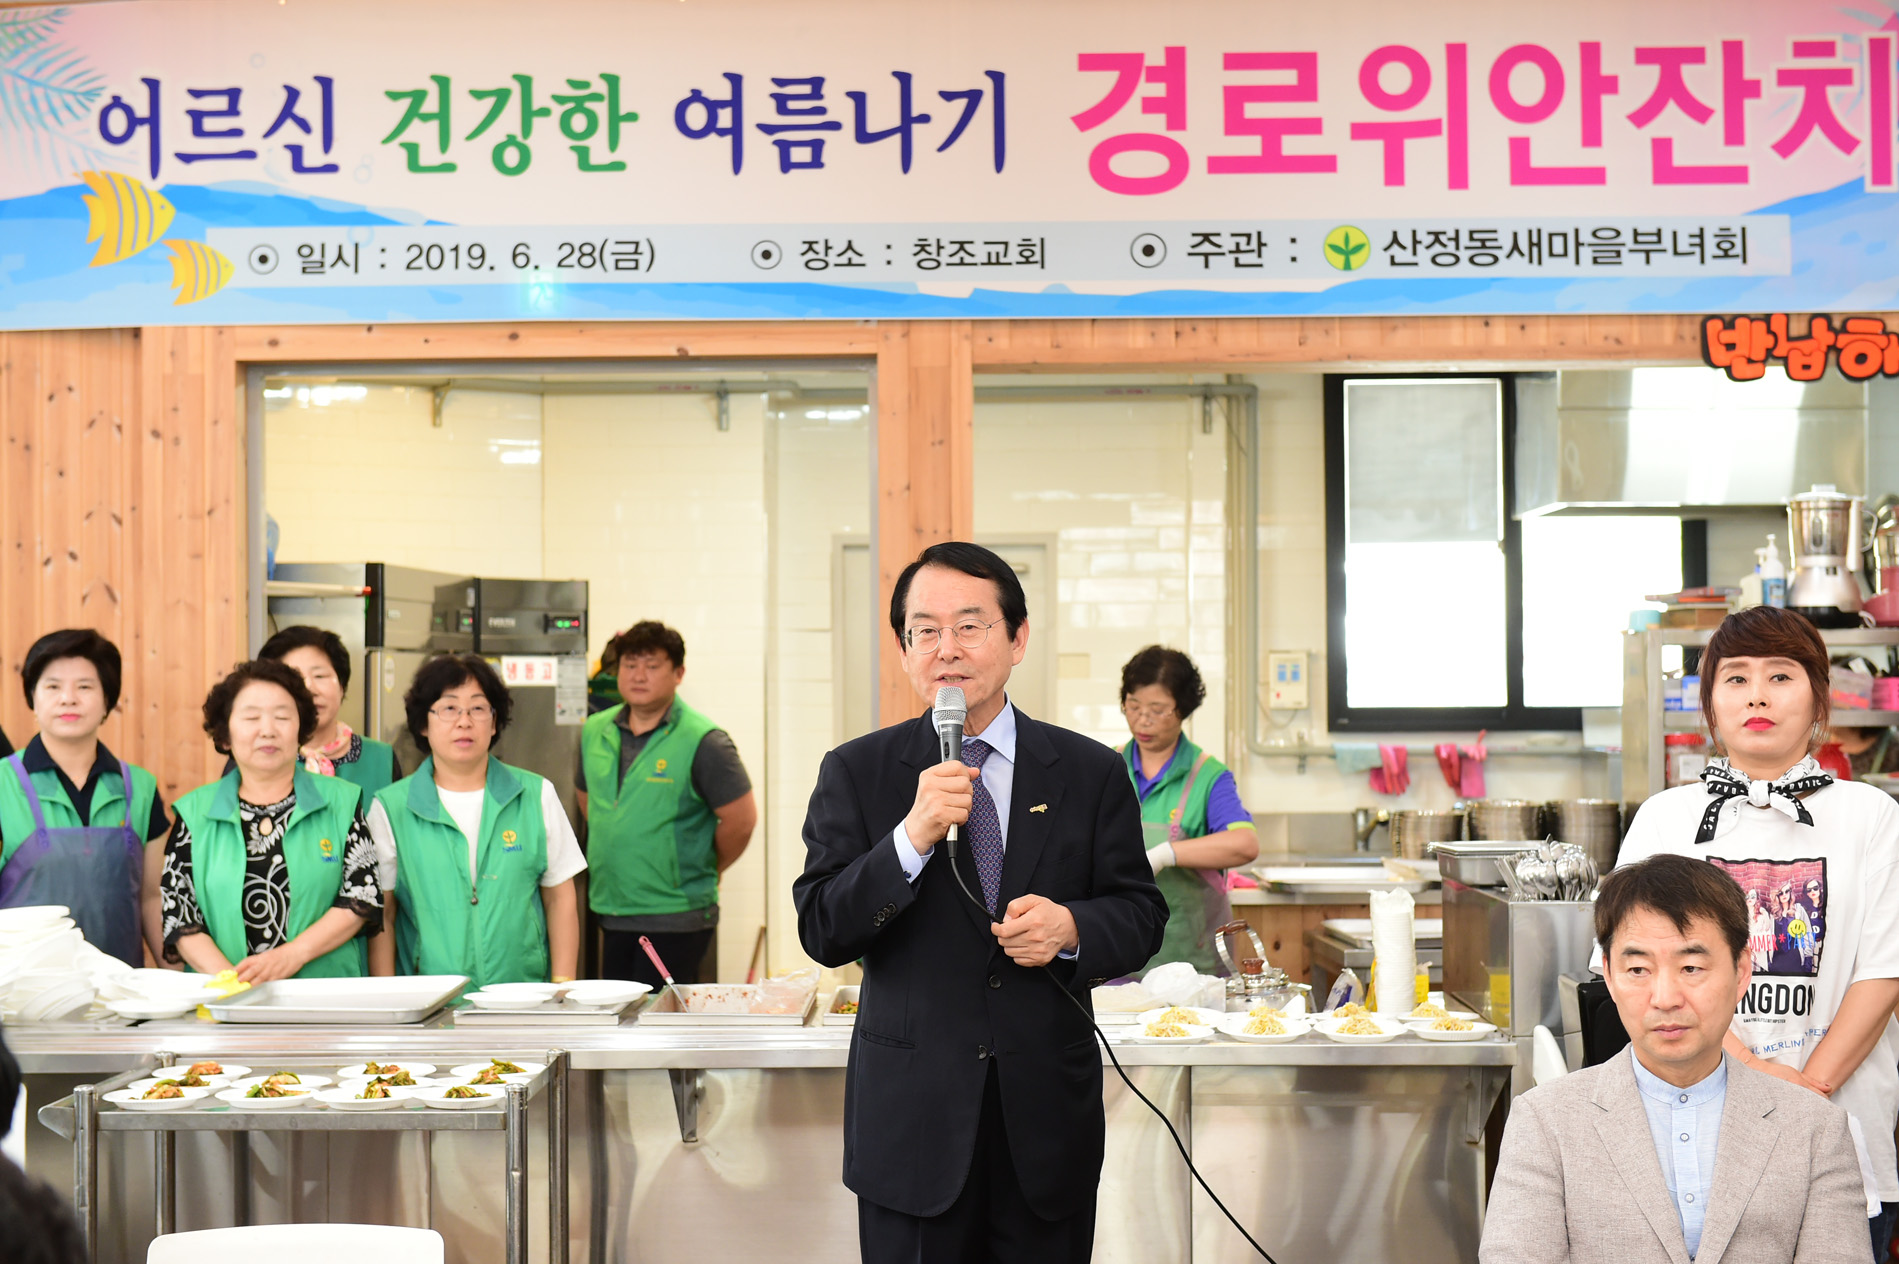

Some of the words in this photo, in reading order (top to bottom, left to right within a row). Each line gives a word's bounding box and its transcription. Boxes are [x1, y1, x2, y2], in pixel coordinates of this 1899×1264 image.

[99, 75, 340, 180] 어르신
[381, 73, 640, 177] 건강한
[674, 70, 1006, 176] 여름나기
[1070, 37, 1892, 196] 경로위안잔치
[297, 242, 360, 274] 일시
[406, 243, 495, 271] 2019.
[511, 243, 540, 271] 6.
[557, 239, 656, 272] 28(금)
[800, 238, 867, 271] 장소
[912, 237, 1046, 271] 창조교회
[1187, 230, 1267, 269] 주관
[1382, 226, 1748, 267] 산정동새마을부녀회
